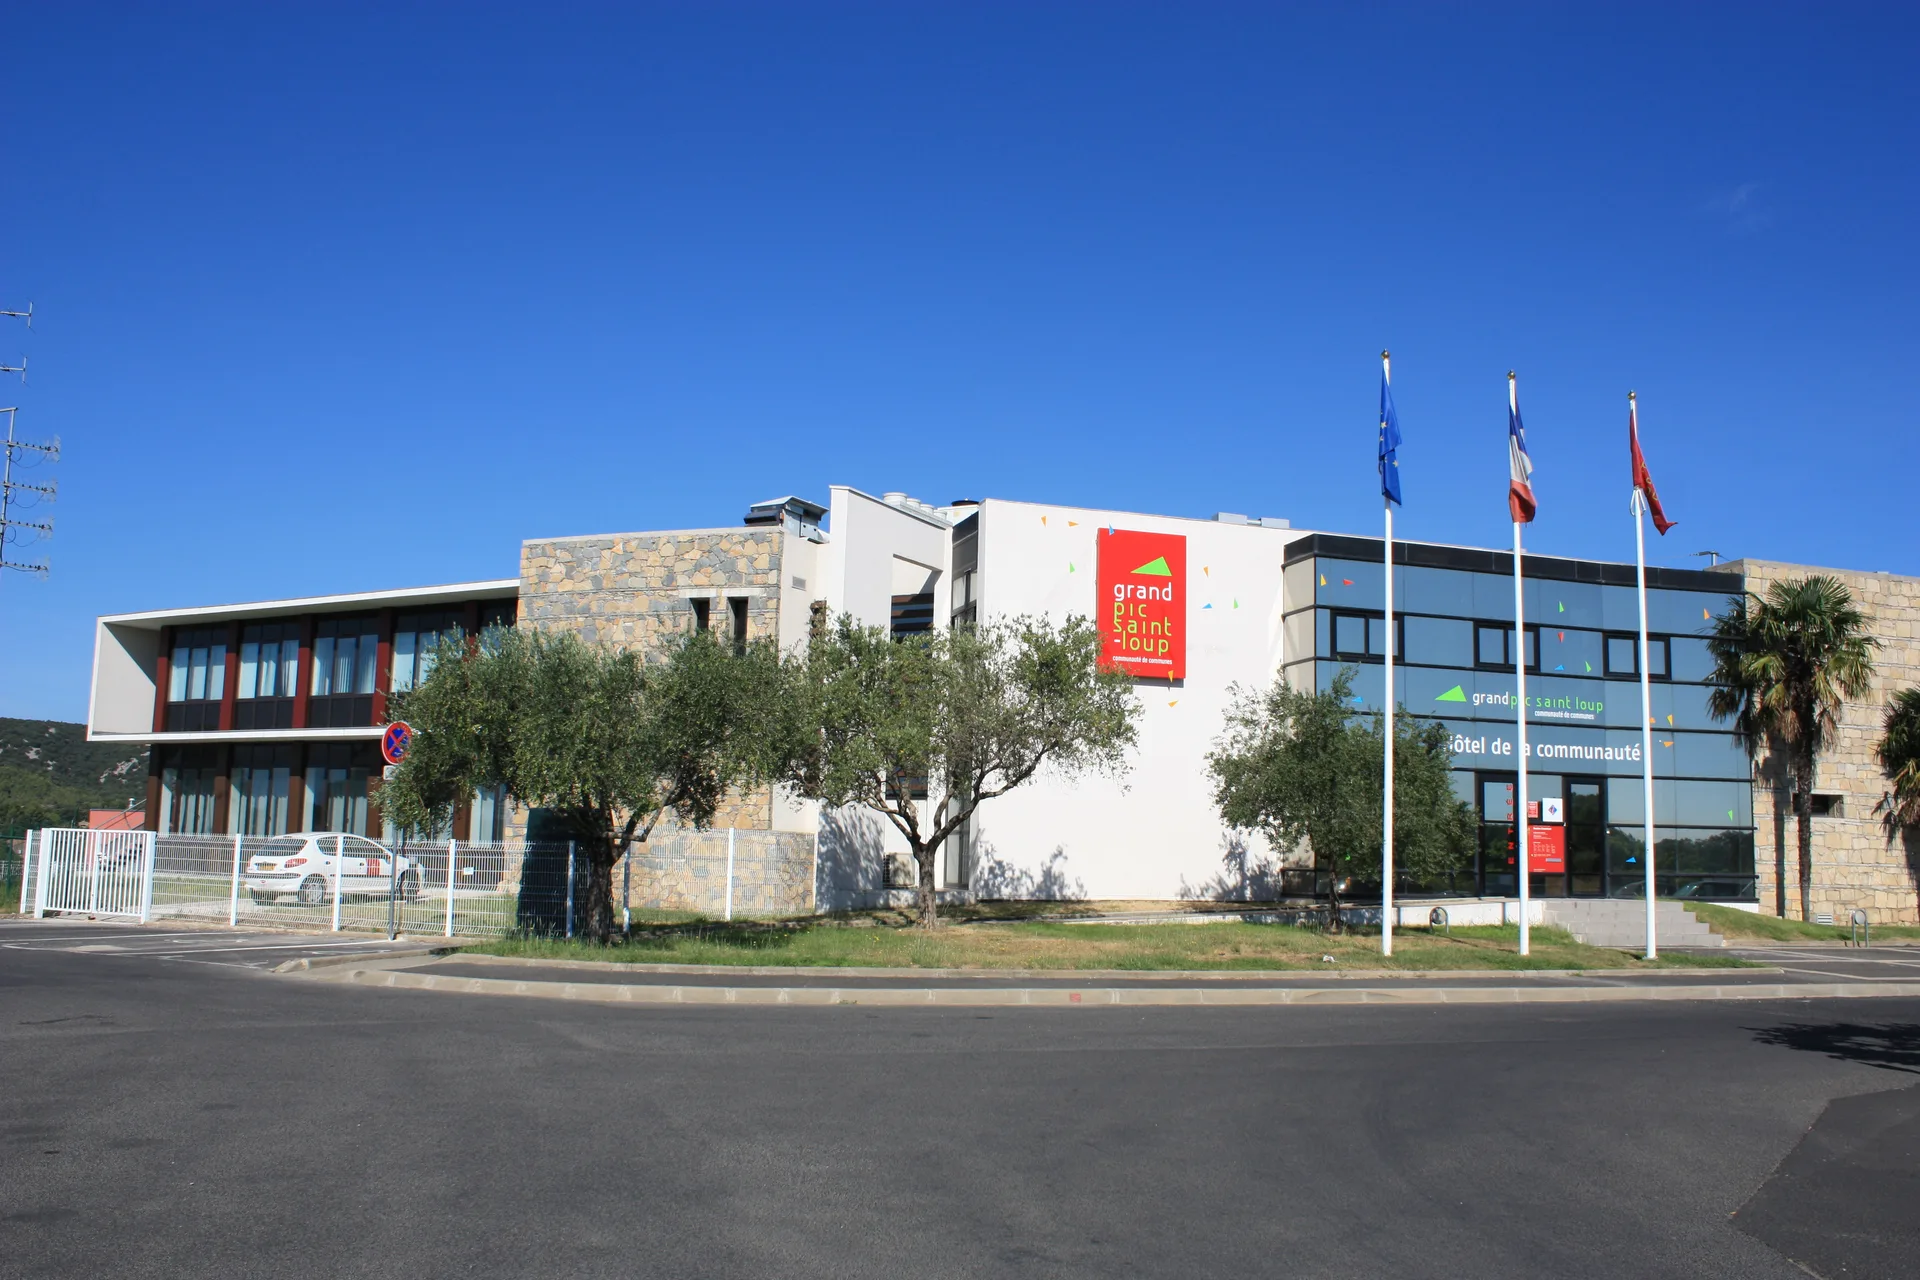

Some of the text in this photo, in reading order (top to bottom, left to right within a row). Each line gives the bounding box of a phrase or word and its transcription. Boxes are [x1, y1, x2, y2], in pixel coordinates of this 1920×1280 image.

[1114, 582, 1172, 601] grand
[1114, 601, 1147, 620] pic
[1114, 631, 1169, 656] -loup
[1472, 691, 1603, 714] grand pc saint loup
[1534, 710, 1563, 718] communauté
[1491, 737, 1511, 755] de
[1536, 743, 1641, 761] communauté
